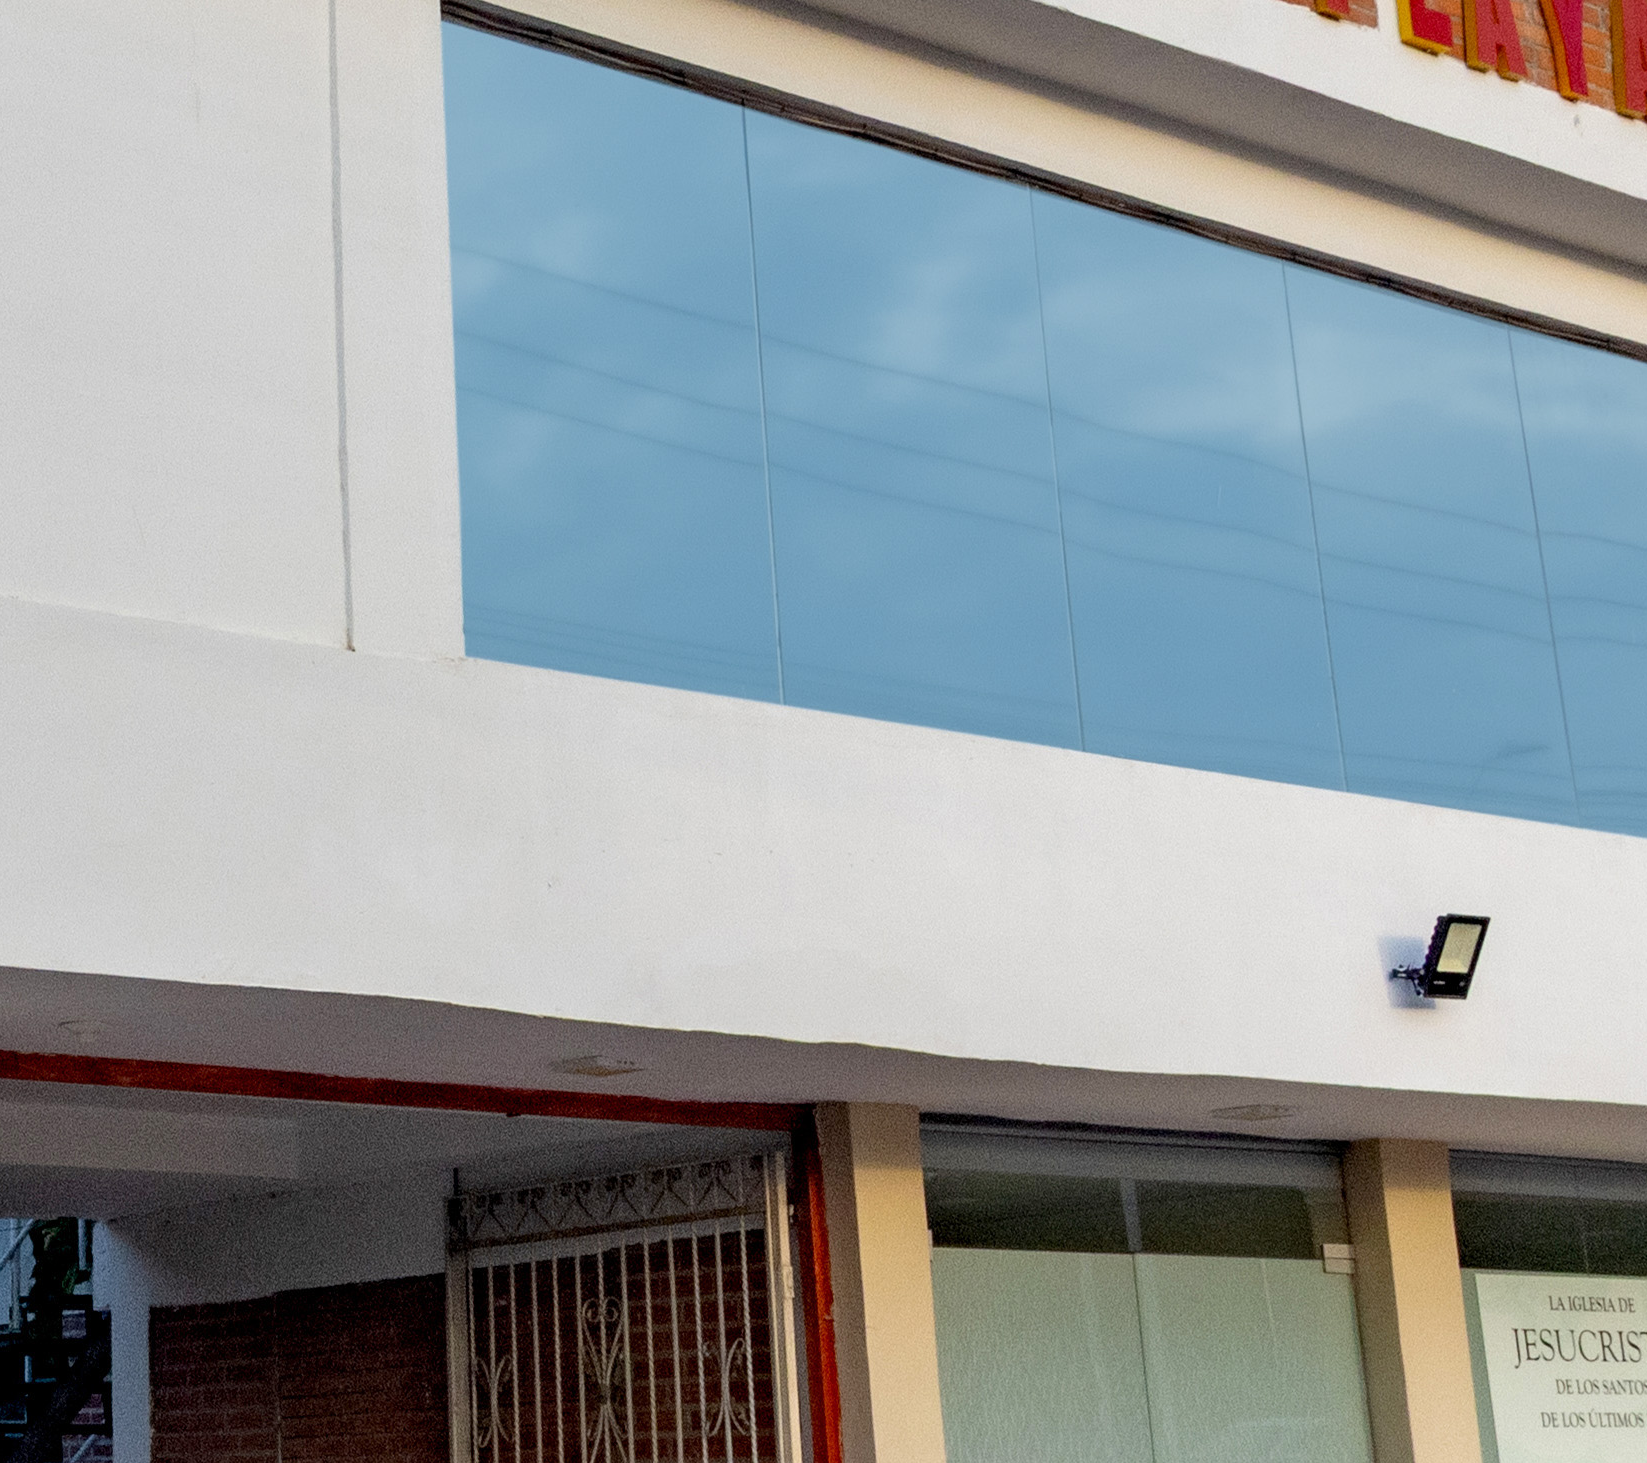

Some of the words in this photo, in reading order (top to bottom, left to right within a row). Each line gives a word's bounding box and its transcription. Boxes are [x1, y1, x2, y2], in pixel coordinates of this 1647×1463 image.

[1548, 1296, 1566, 1311] LA
[1567, 1296, 1616, 1313] IGLESIA
[1618, 1297, 1636, 1313] DE
[1555, 1379, 1574, 1395] DE
[1575, 1379, 1600, 1395] LOS
[1540, 1411, 1559, 1428] DE
[1561, 1411, 1586, 1428] LOS
[1588, 1408, 1645, 1428] ÚLTIMOS
